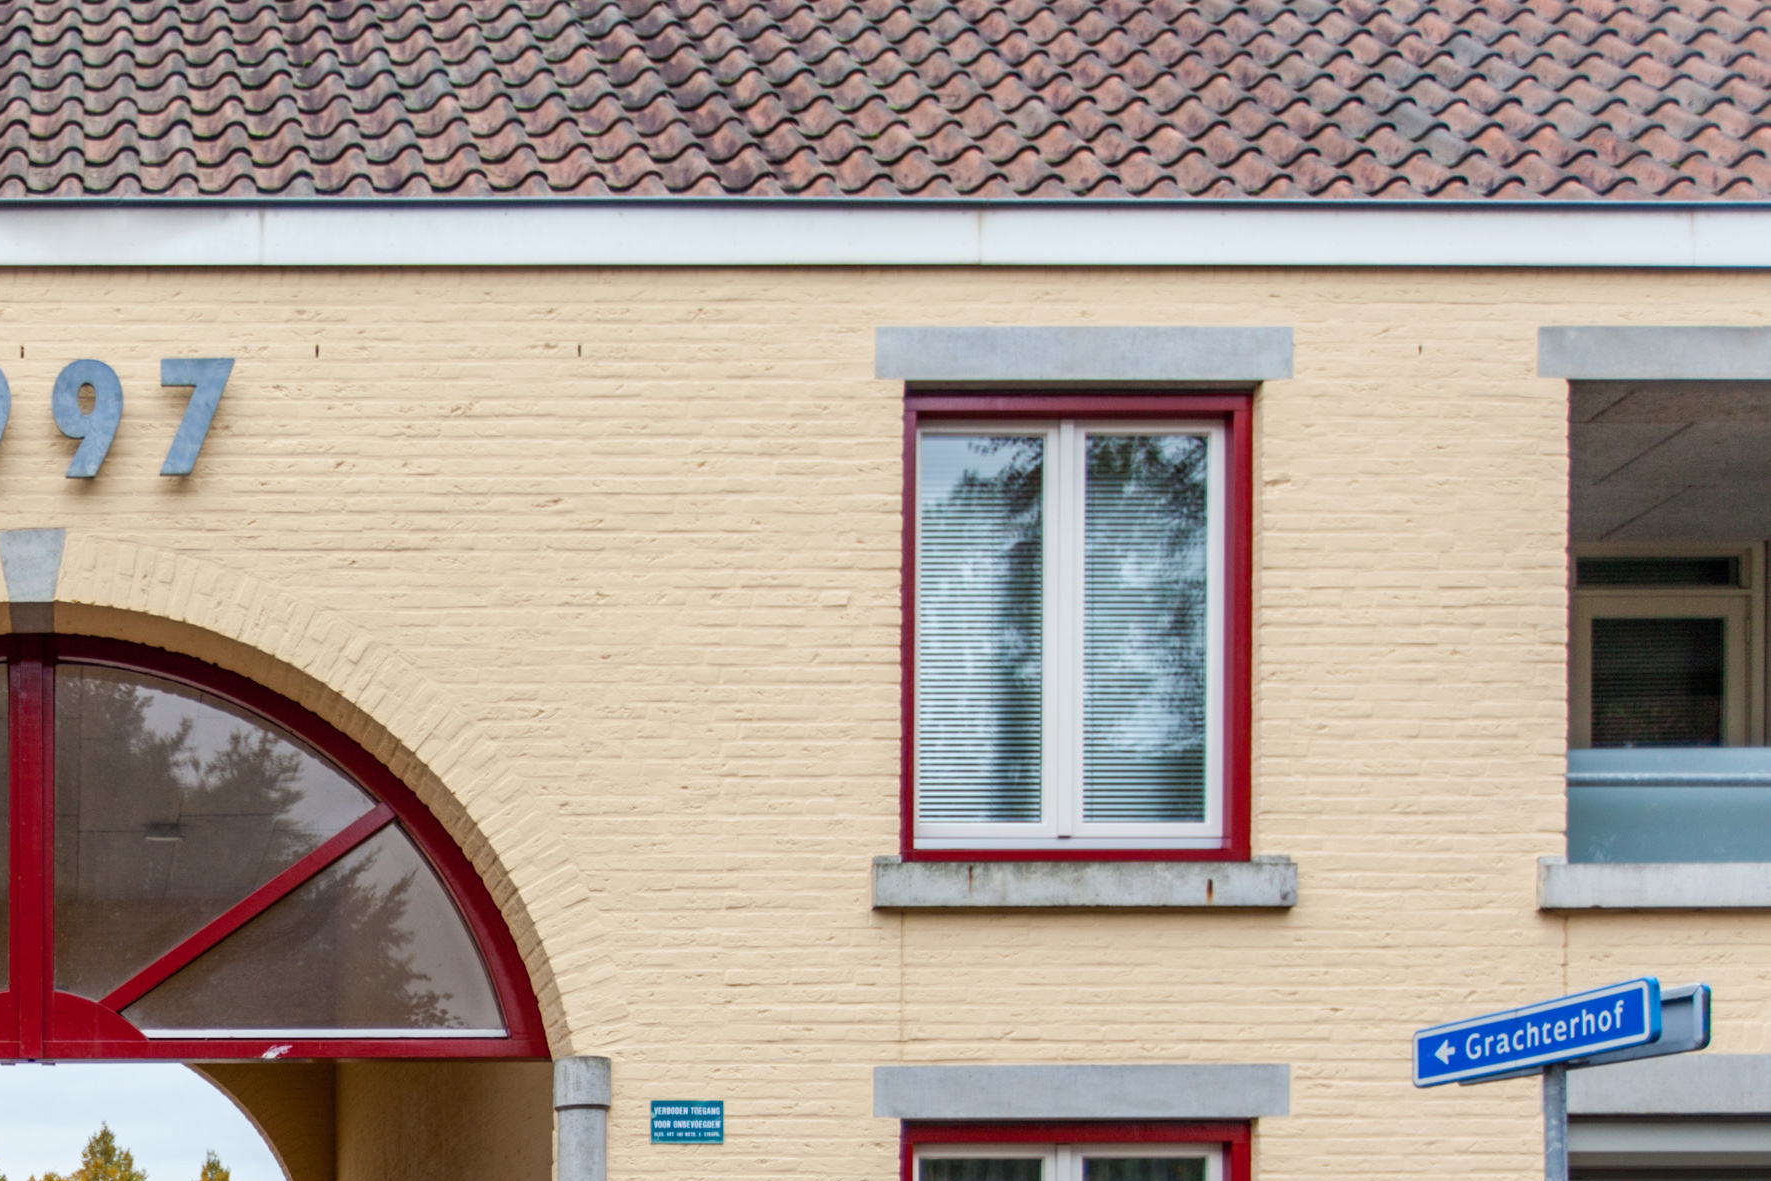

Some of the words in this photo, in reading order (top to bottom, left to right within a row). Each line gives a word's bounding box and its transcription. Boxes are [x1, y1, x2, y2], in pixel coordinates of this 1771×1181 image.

[1465, 999, 1625, 1060] Grachterhof
[653, 1106, 689, 1116] VERBODEN
[690, 1106, 721, 1116] TOEGANG
[653, 1120, 671, 1129] VOOR
[673, 1120, 722, 1129] ONBEVOEGDEN
